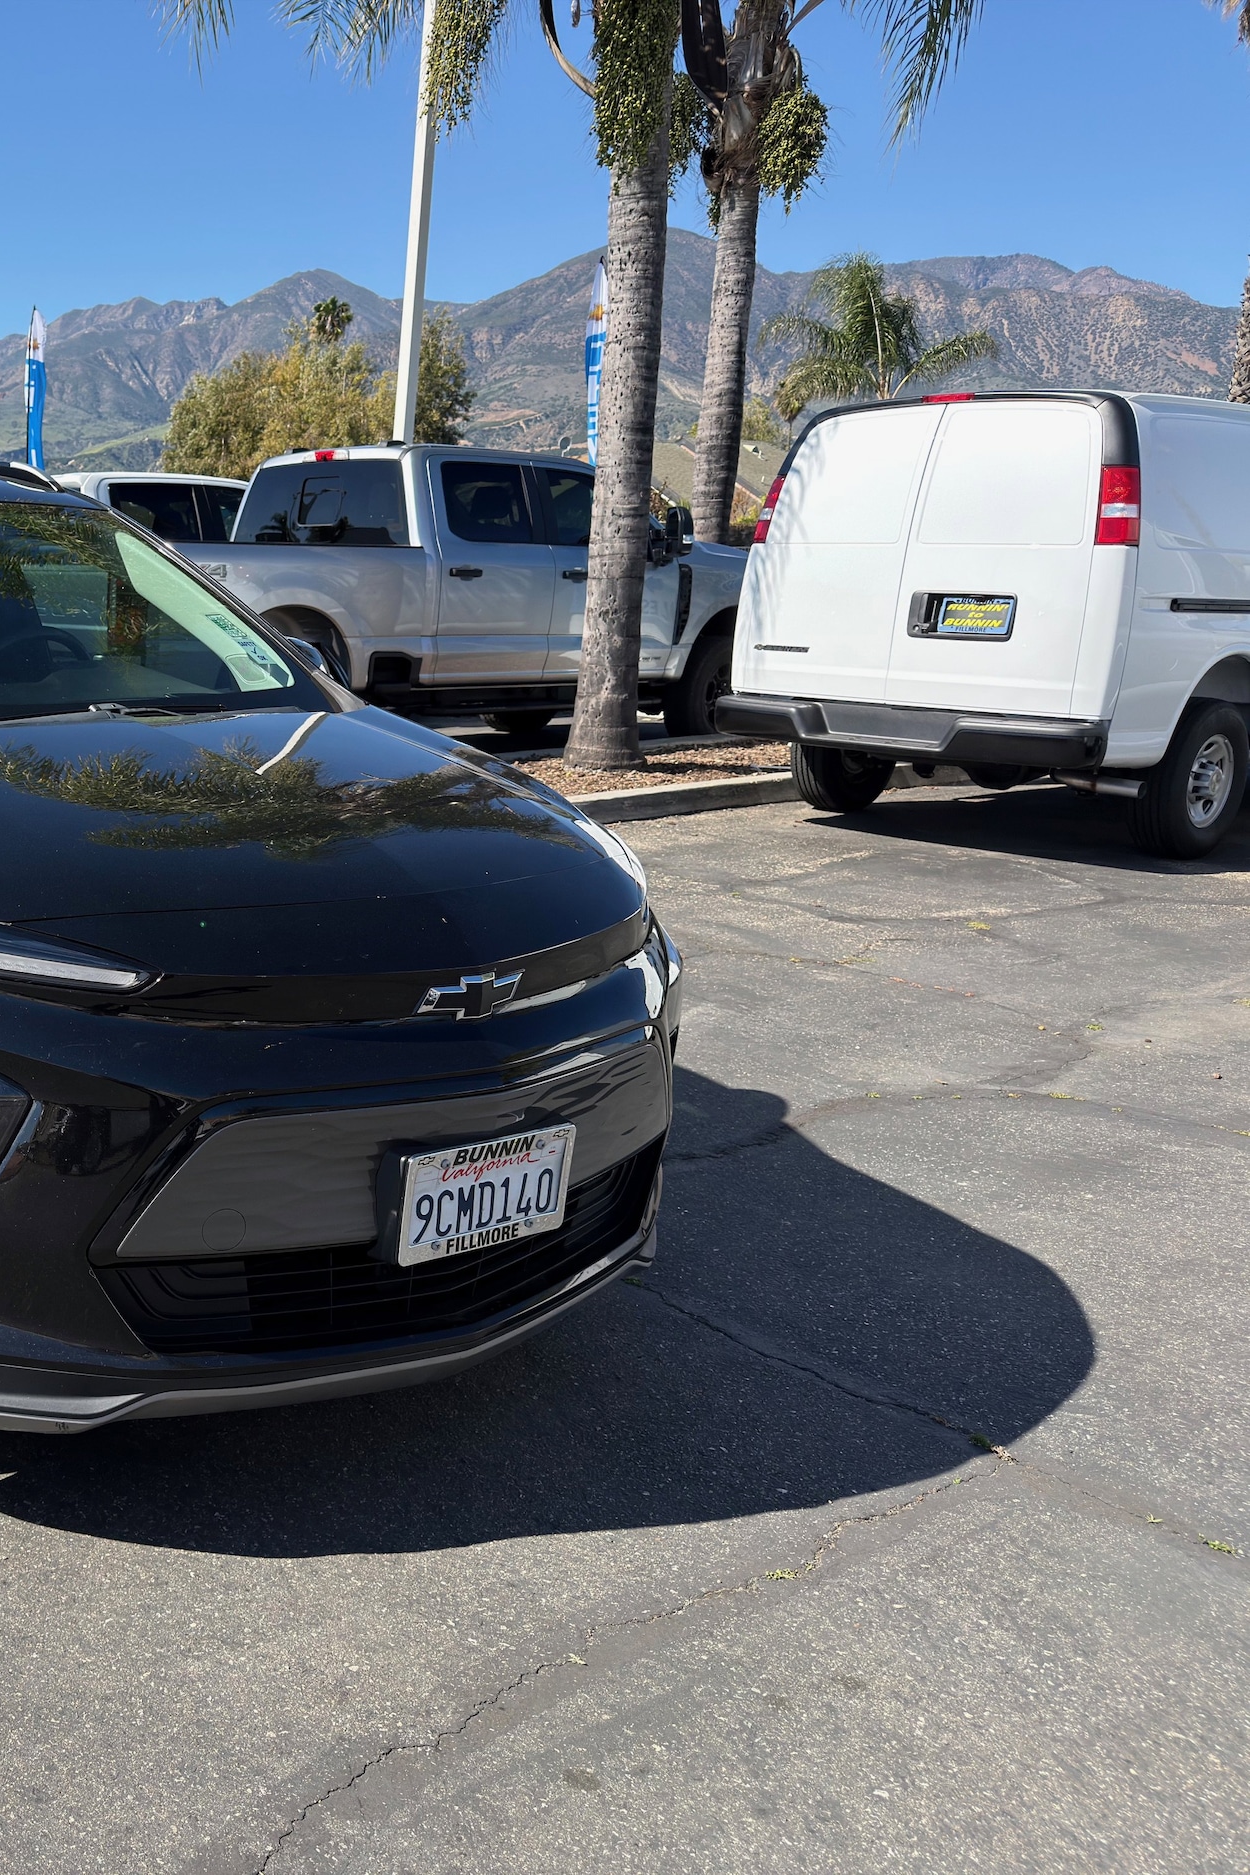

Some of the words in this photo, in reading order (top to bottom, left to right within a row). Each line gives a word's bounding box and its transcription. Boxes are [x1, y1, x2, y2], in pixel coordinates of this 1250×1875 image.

[943, 618, 1003, 627] BUNNIN
[441, 1151, 541, 1183] California
[452, 1134, 536, 1167] BUNNIN
[413, 1168, 554, 1244] 9CMD140
[445, 1222, 520, 1255] FILLMORE
